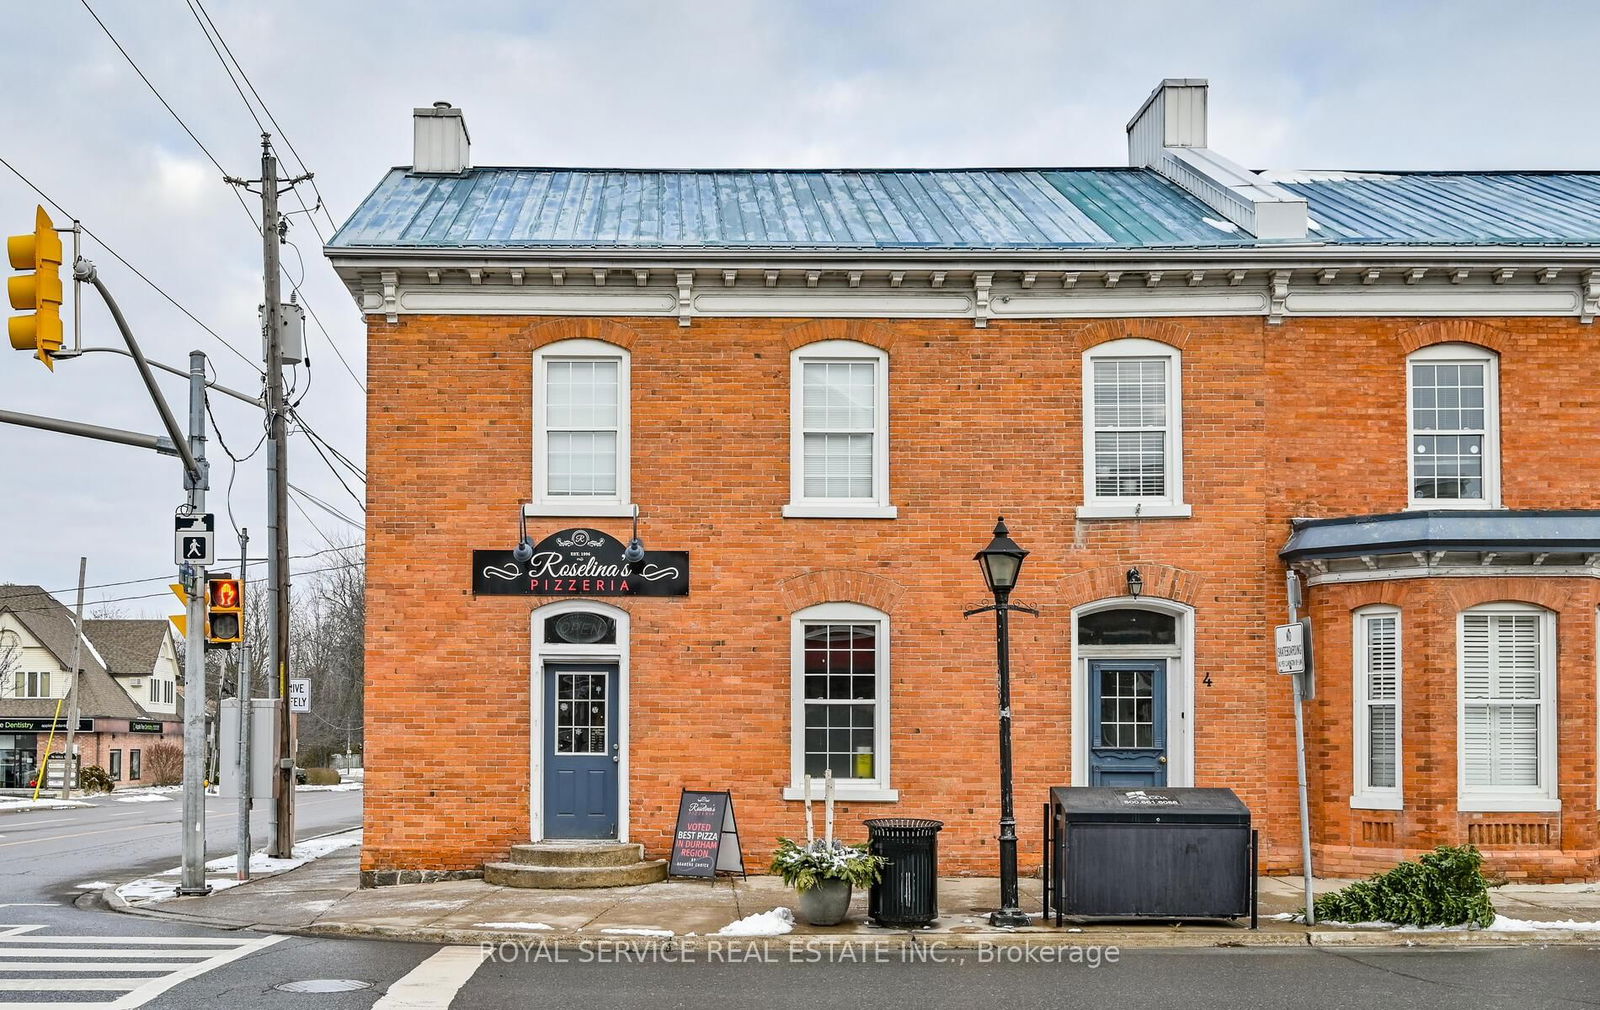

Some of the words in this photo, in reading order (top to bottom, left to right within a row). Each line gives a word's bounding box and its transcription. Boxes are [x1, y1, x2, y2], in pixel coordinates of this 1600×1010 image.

[528, 551, 632, 578] Roselina's
[531, 580, 629, 591] PIZZERIA
[559, 620, 602, 635] OPEN
[1202, 672, 1213, 687] 4
[5, 721, 34, 730] Dentistry
[687, 823, 711, 831] VOTED
[678, 831, 696, 839] BEST
[697, 832, 718, 840] PIZZA
[676, 840, 683, 848] IN
[686, 840, 717, 849] DURHAM
[682, 849, 709, 857] REGION
